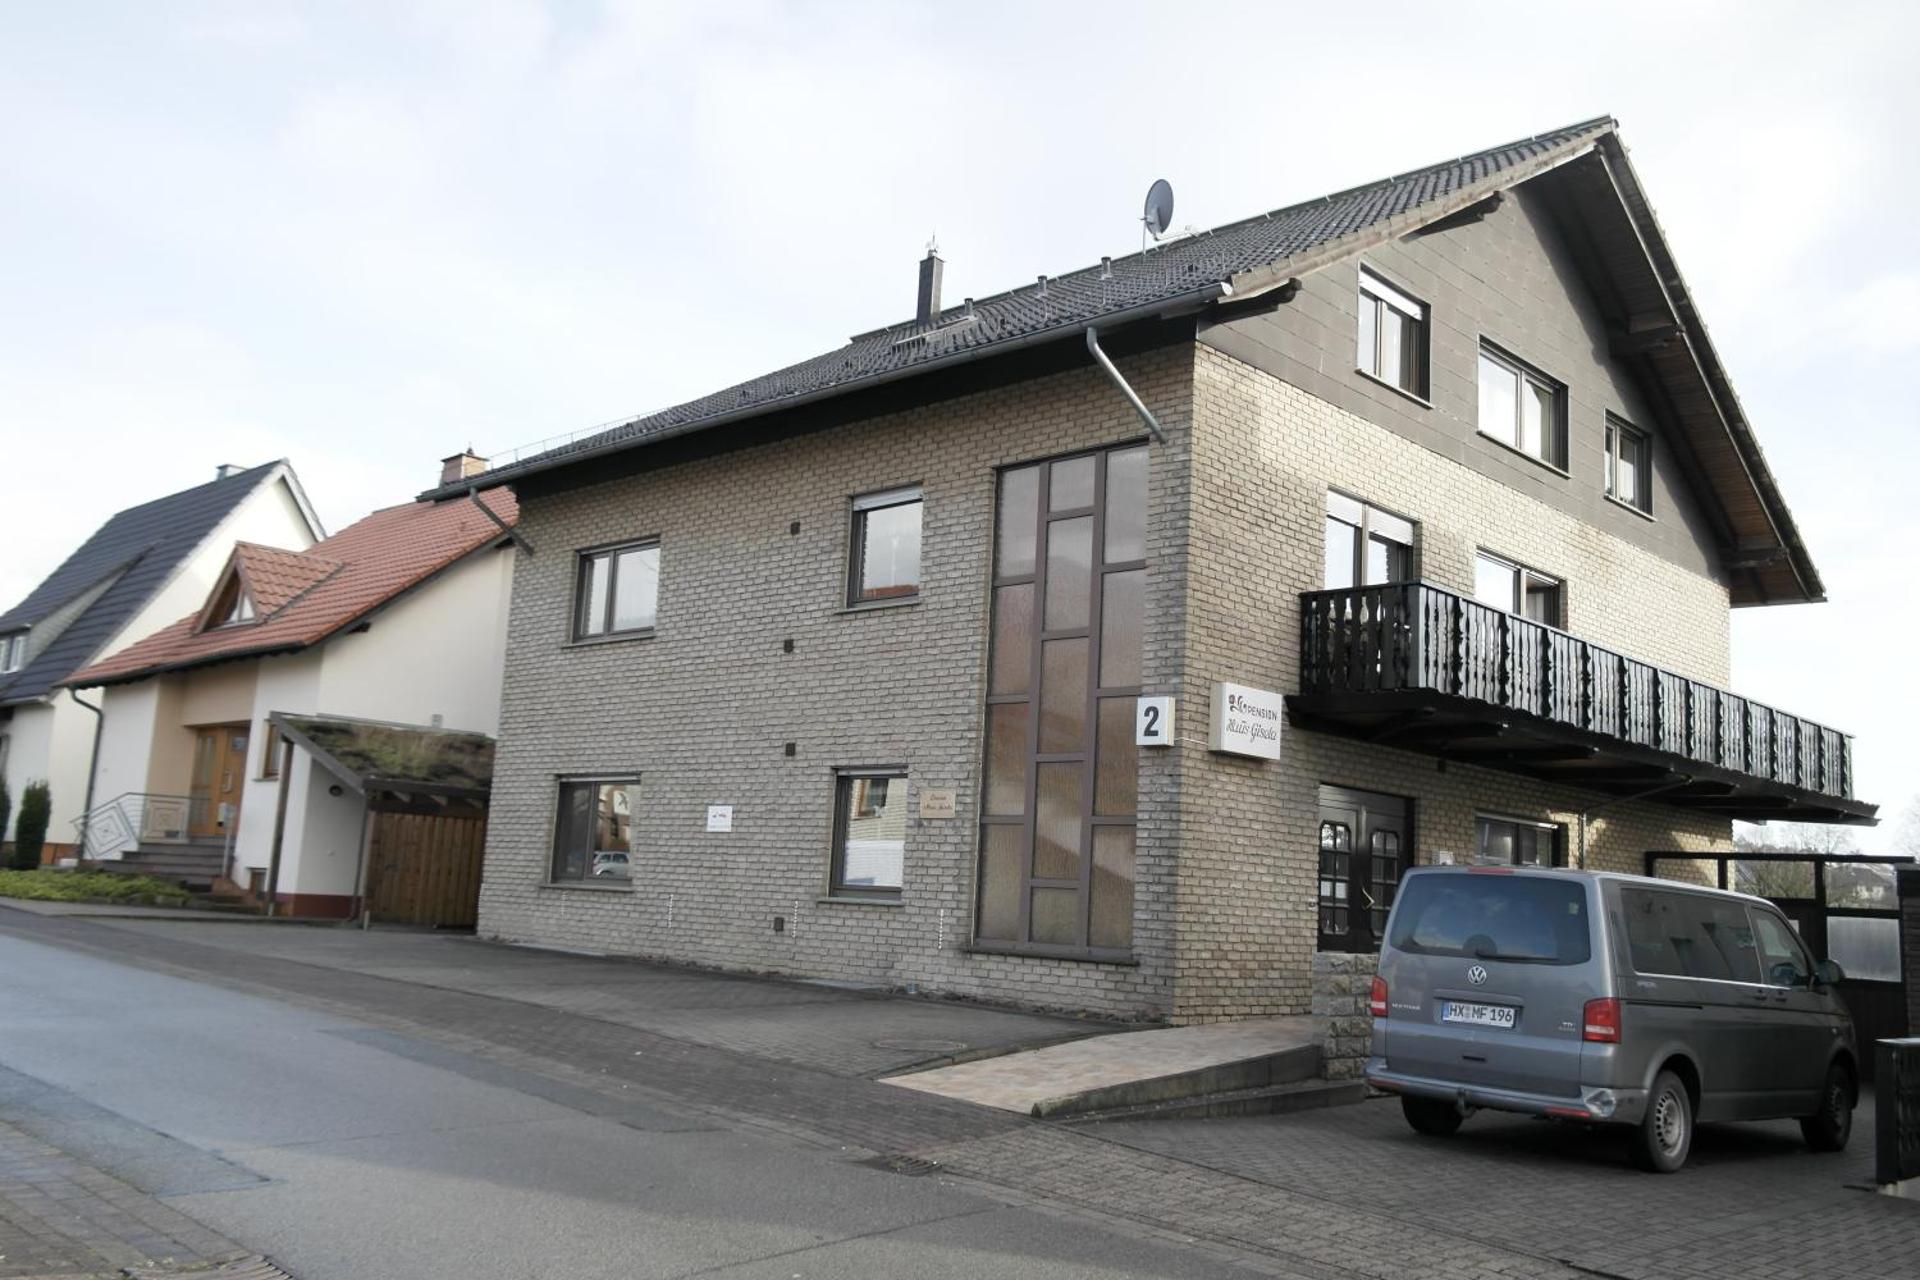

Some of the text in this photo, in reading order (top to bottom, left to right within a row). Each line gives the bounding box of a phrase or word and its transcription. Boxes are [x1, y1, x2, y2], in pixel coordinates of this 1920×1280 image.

[1144, 706, 1159, 737] 2
[1449, 1004, 1513, 1022] HX MF 196
